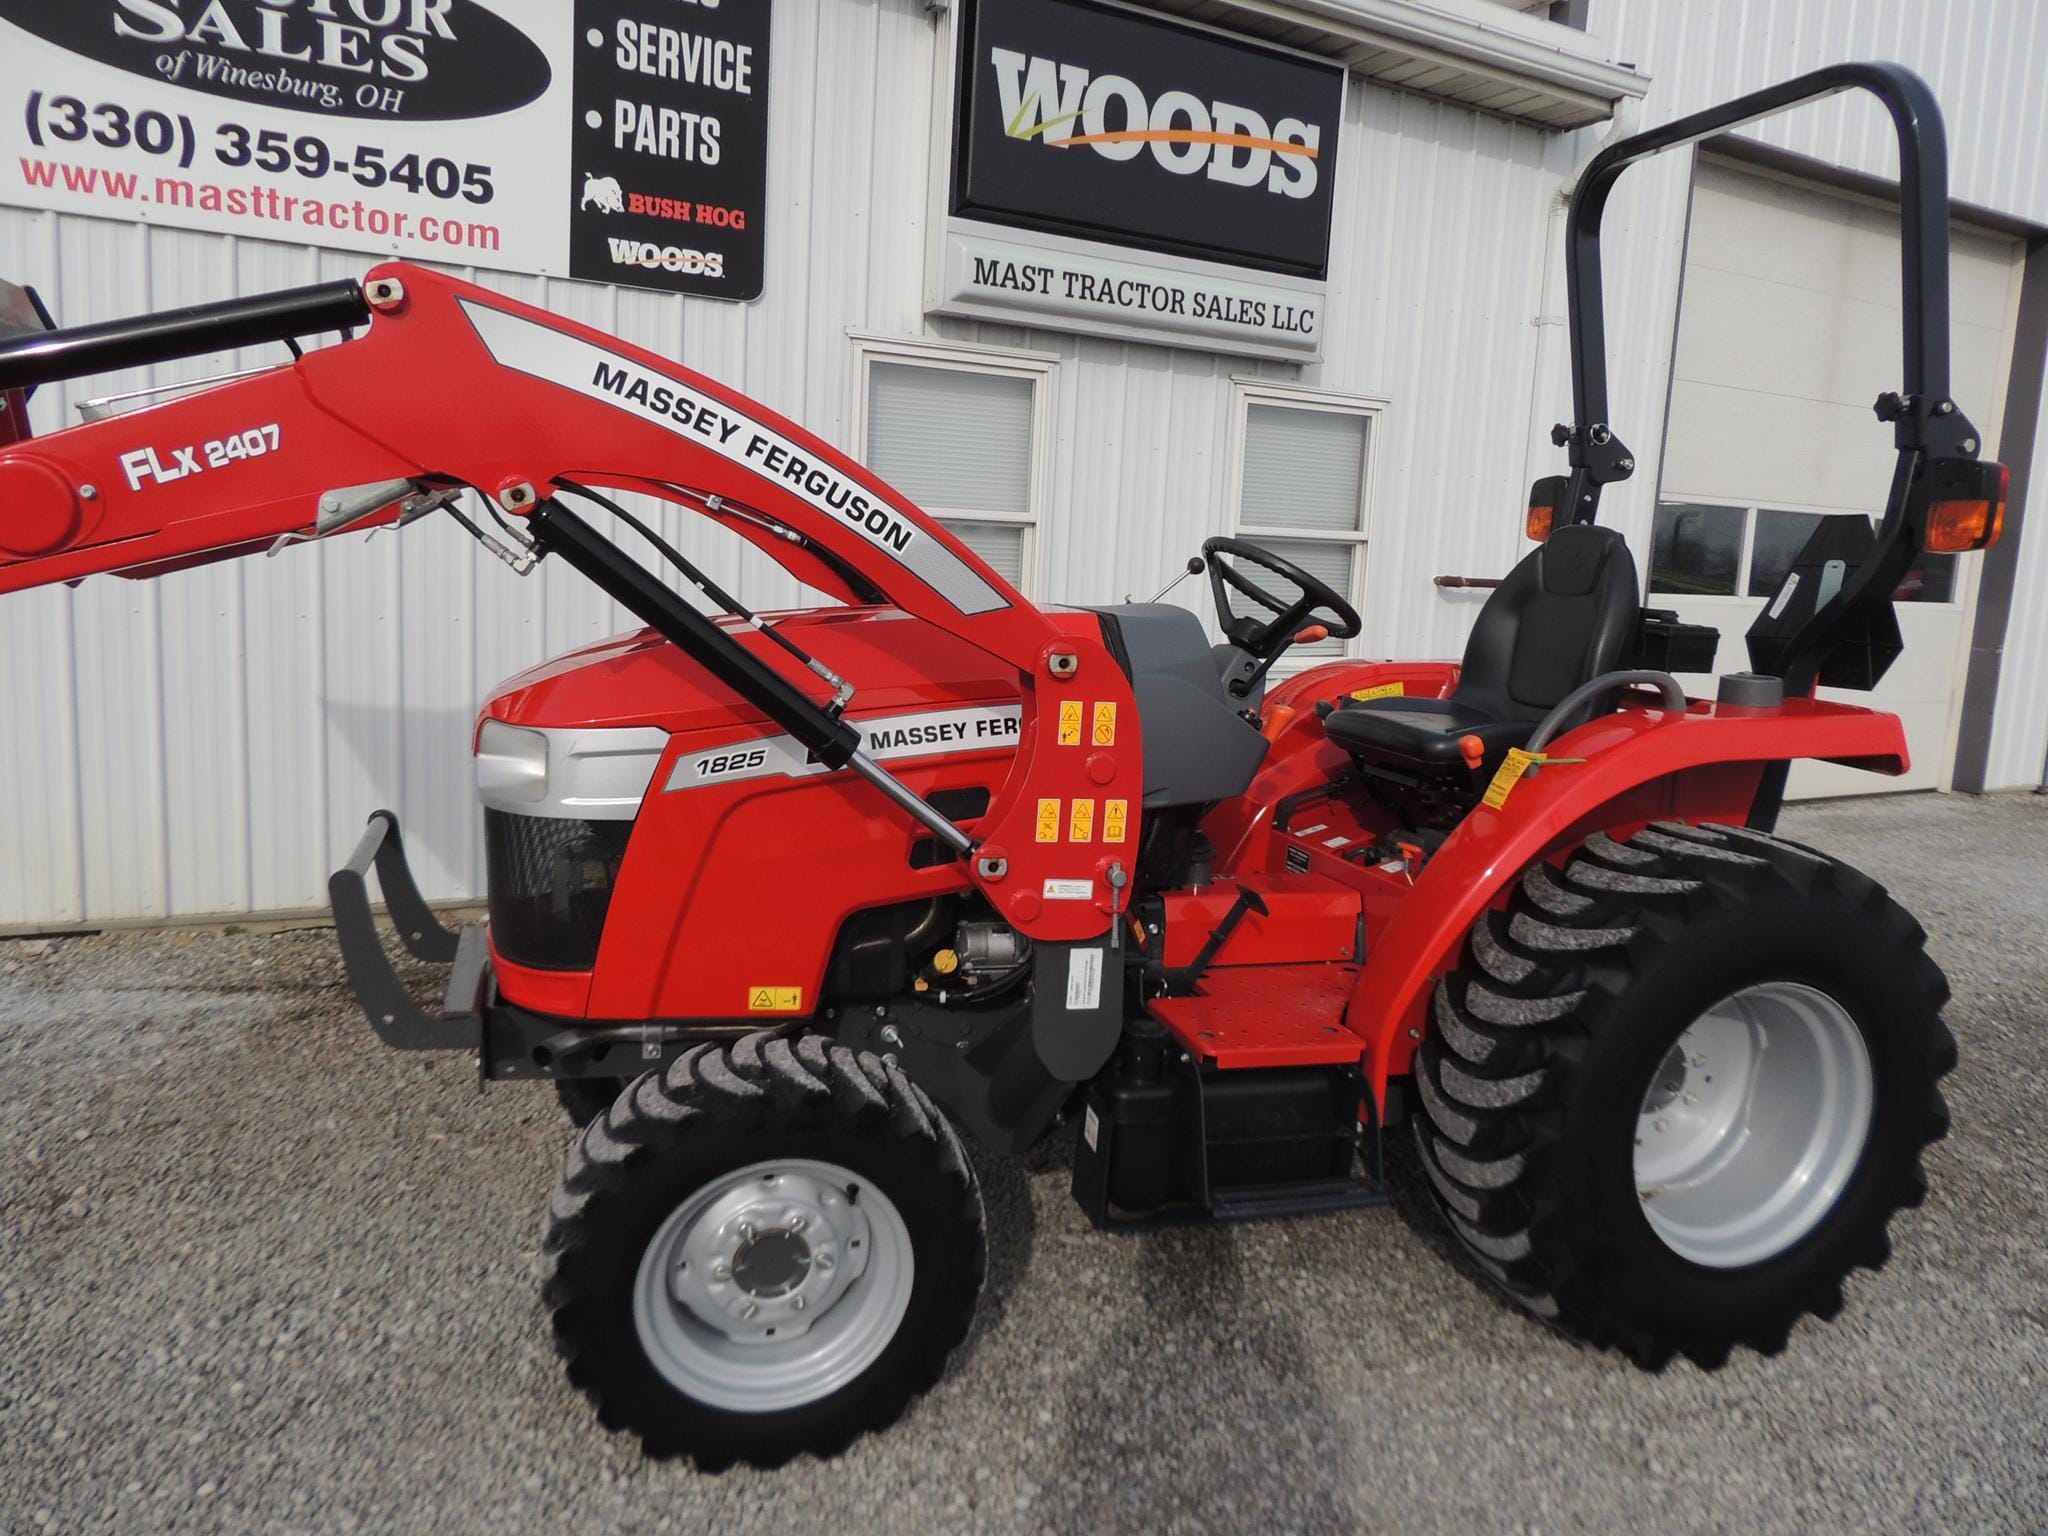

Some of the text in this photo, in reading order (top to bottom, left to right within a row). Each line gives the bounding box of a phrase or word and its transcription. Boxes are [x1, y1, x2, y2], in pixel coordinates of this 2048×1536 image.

[113, 0, 429, 81] SALES
[616, 18, 753, 94] SERVICE
[155, 51, 405, 113] of Winesburg, OH
[25, 90, 494, 204] (330) 359-5405
[614, 98, 721, 166] PARTS
[991, 46, 1321, 199] WOODS
[19, 157, 500, 250] www.masttractor.com
[628, 192, 746, 230] BUSH HOG
[607, 236, 725, 279] WOODS
[973, 257, 1315, 335] MAST TRACTOR SALES LLC
[204, 423, 280, 469] 2407
[591, 361, 913, 553] MASSEY FERGUSON
[696, 749, 766, 777] 1825
[870, 717, 1021, 751] MASSEY FER
